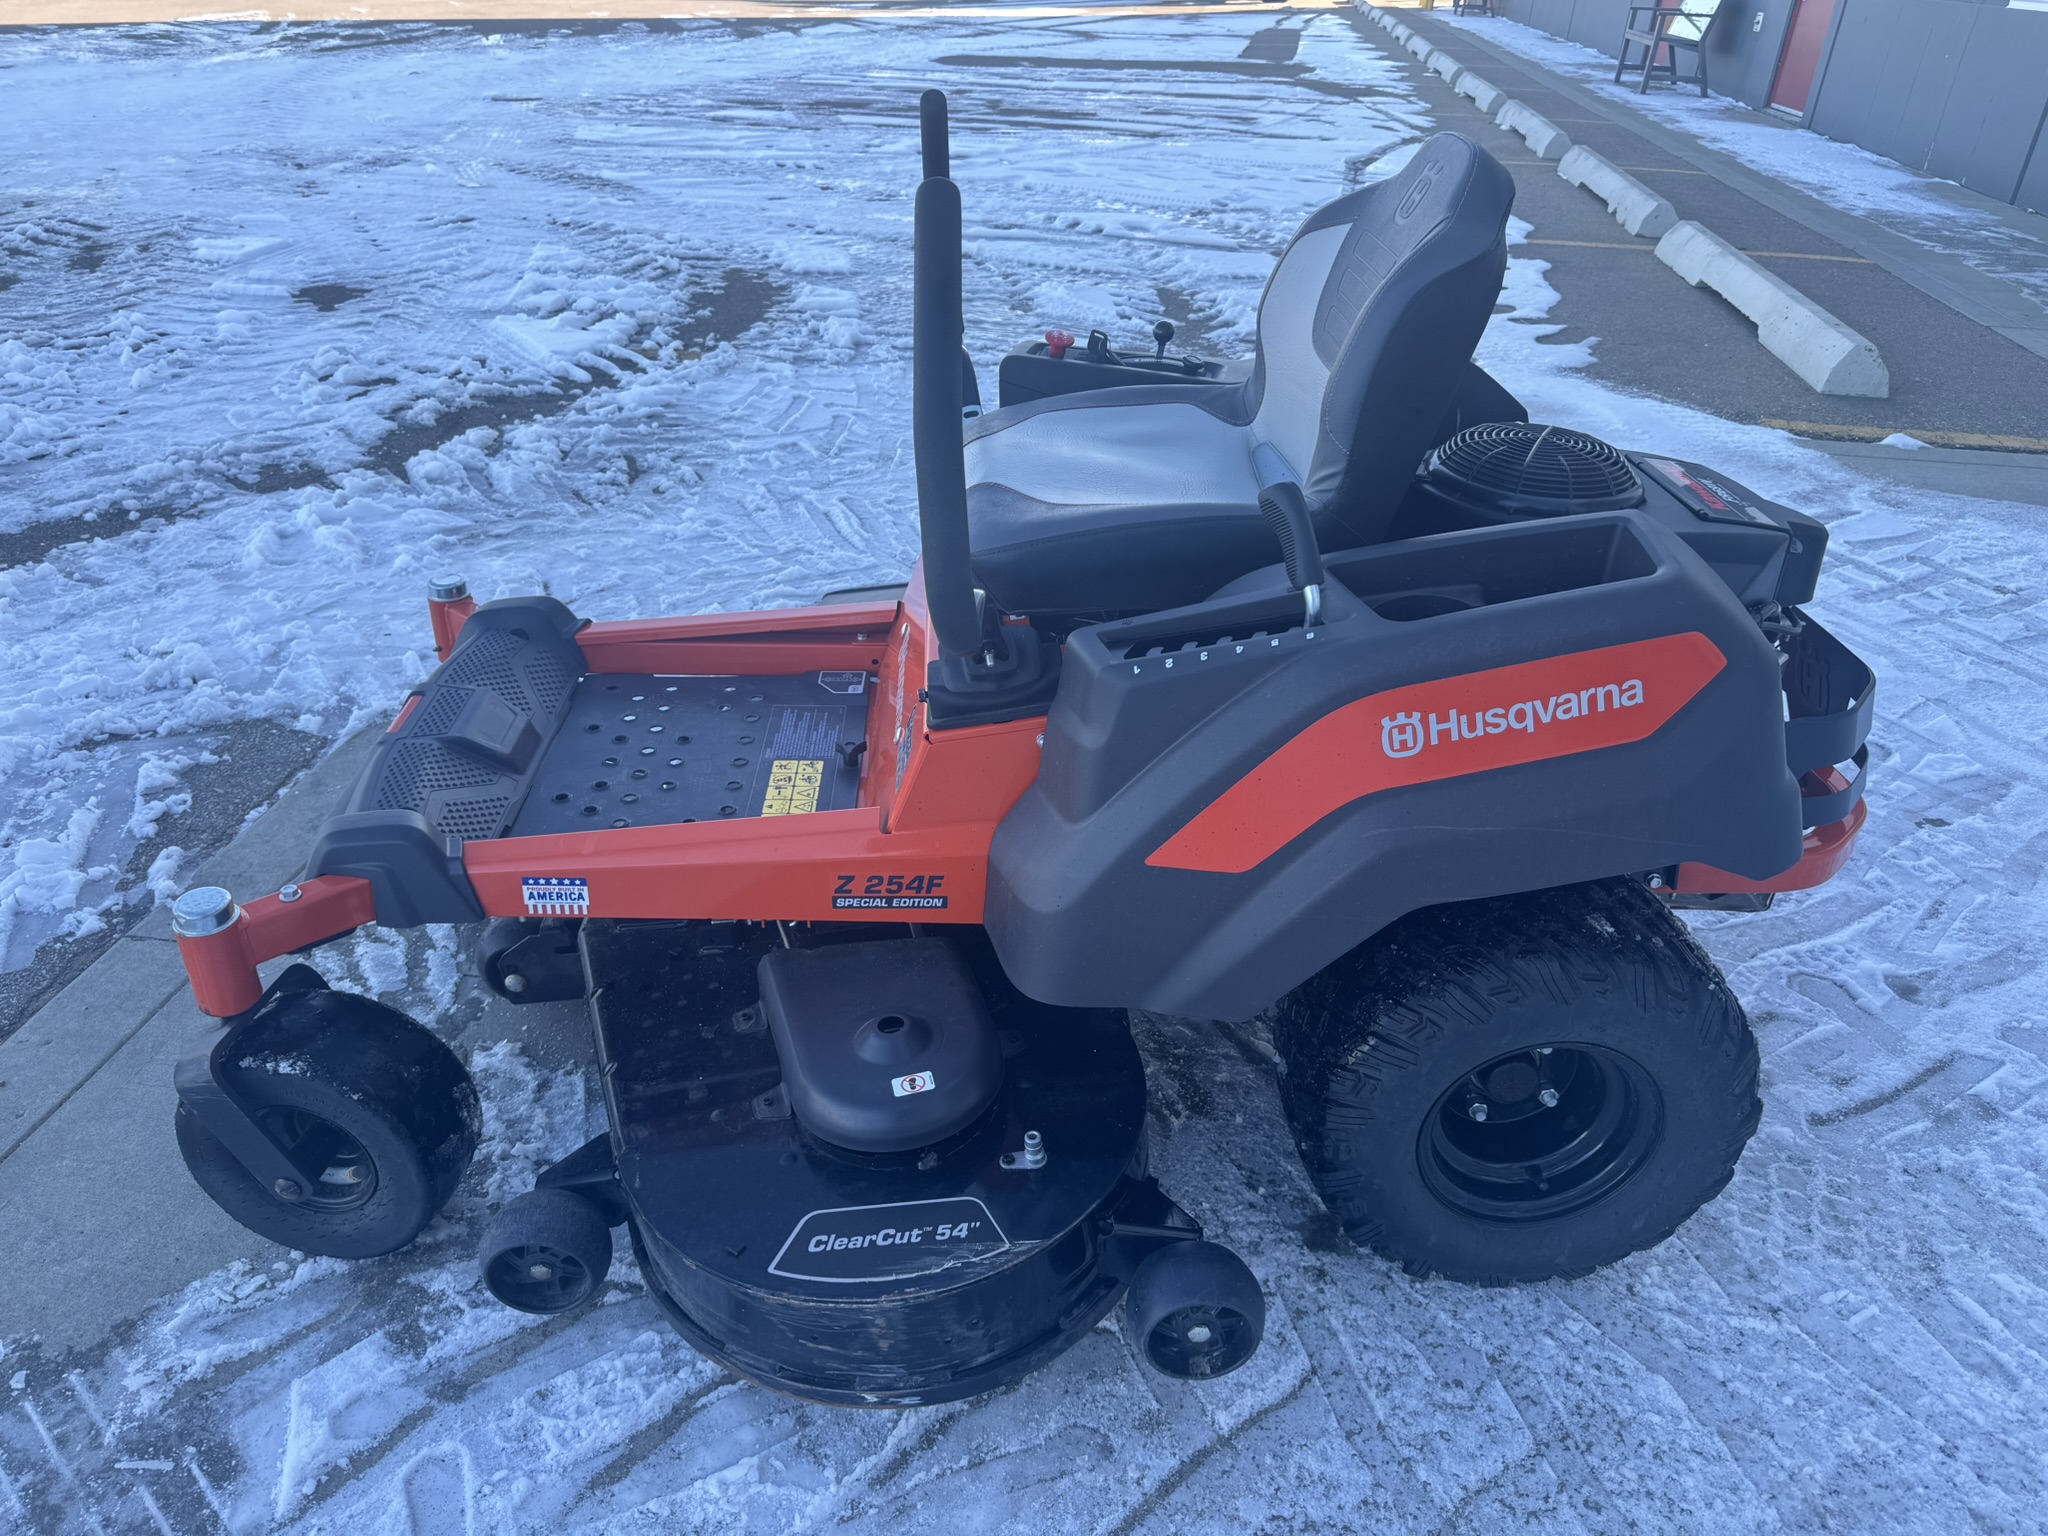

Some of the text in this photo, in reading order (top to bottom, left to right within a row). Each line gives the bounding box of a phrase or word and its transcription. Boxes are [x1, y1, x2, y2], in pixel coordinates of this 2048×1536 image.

[1133, 665, 1141, 675] 1
[1165, 658, 1174, 668] 2
[1200, 651, 1208, 661] 3
[1235, 645, 1244, 654] 4
[1270, 638, 1280, 647] 5
[1428, 679, 1644, 745] Husqvarna
[834, 875, 945, 895] Z 254F
[528, 892, 586, 902] AMERICA
[836, 898, 943, 907] SPECIAL EDITION
